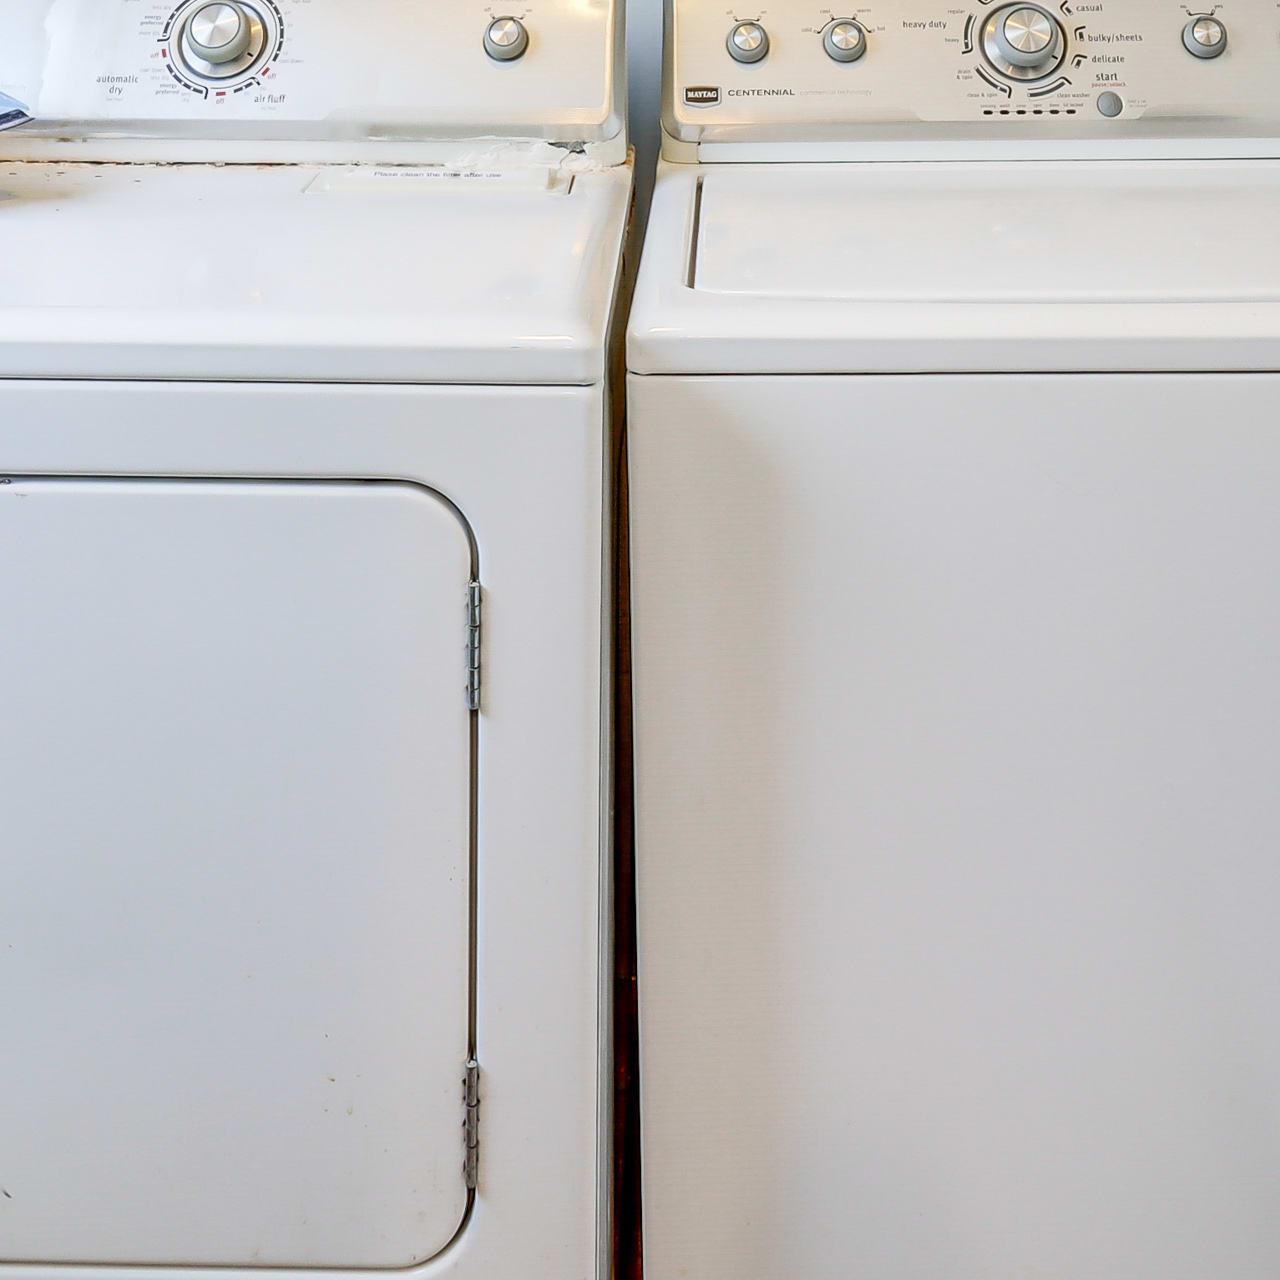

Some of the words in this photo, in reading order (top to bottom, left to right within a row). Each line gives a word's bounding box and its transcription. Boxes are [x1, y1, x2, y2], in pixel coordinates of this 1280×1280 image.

[1076, 3, 1103, 12] casual
[902, 20, 927, 30] heavy
[928, 20, 947, 30] duty
[1087, 33, 1144, 44] bulky/sheets
[1091, 54, 1126, 63] delicate
[96, 74, 139, 84] automatic
[1095, 72, 1119, 81] start
[108, 85, 123, 96] dry
[687, 90, 718, 99] MAYTAG
[727, 88, 796, 97] CENTENNIAL
[254, 95, 266, 103] air
[267, 94, 286, 104] fluff
